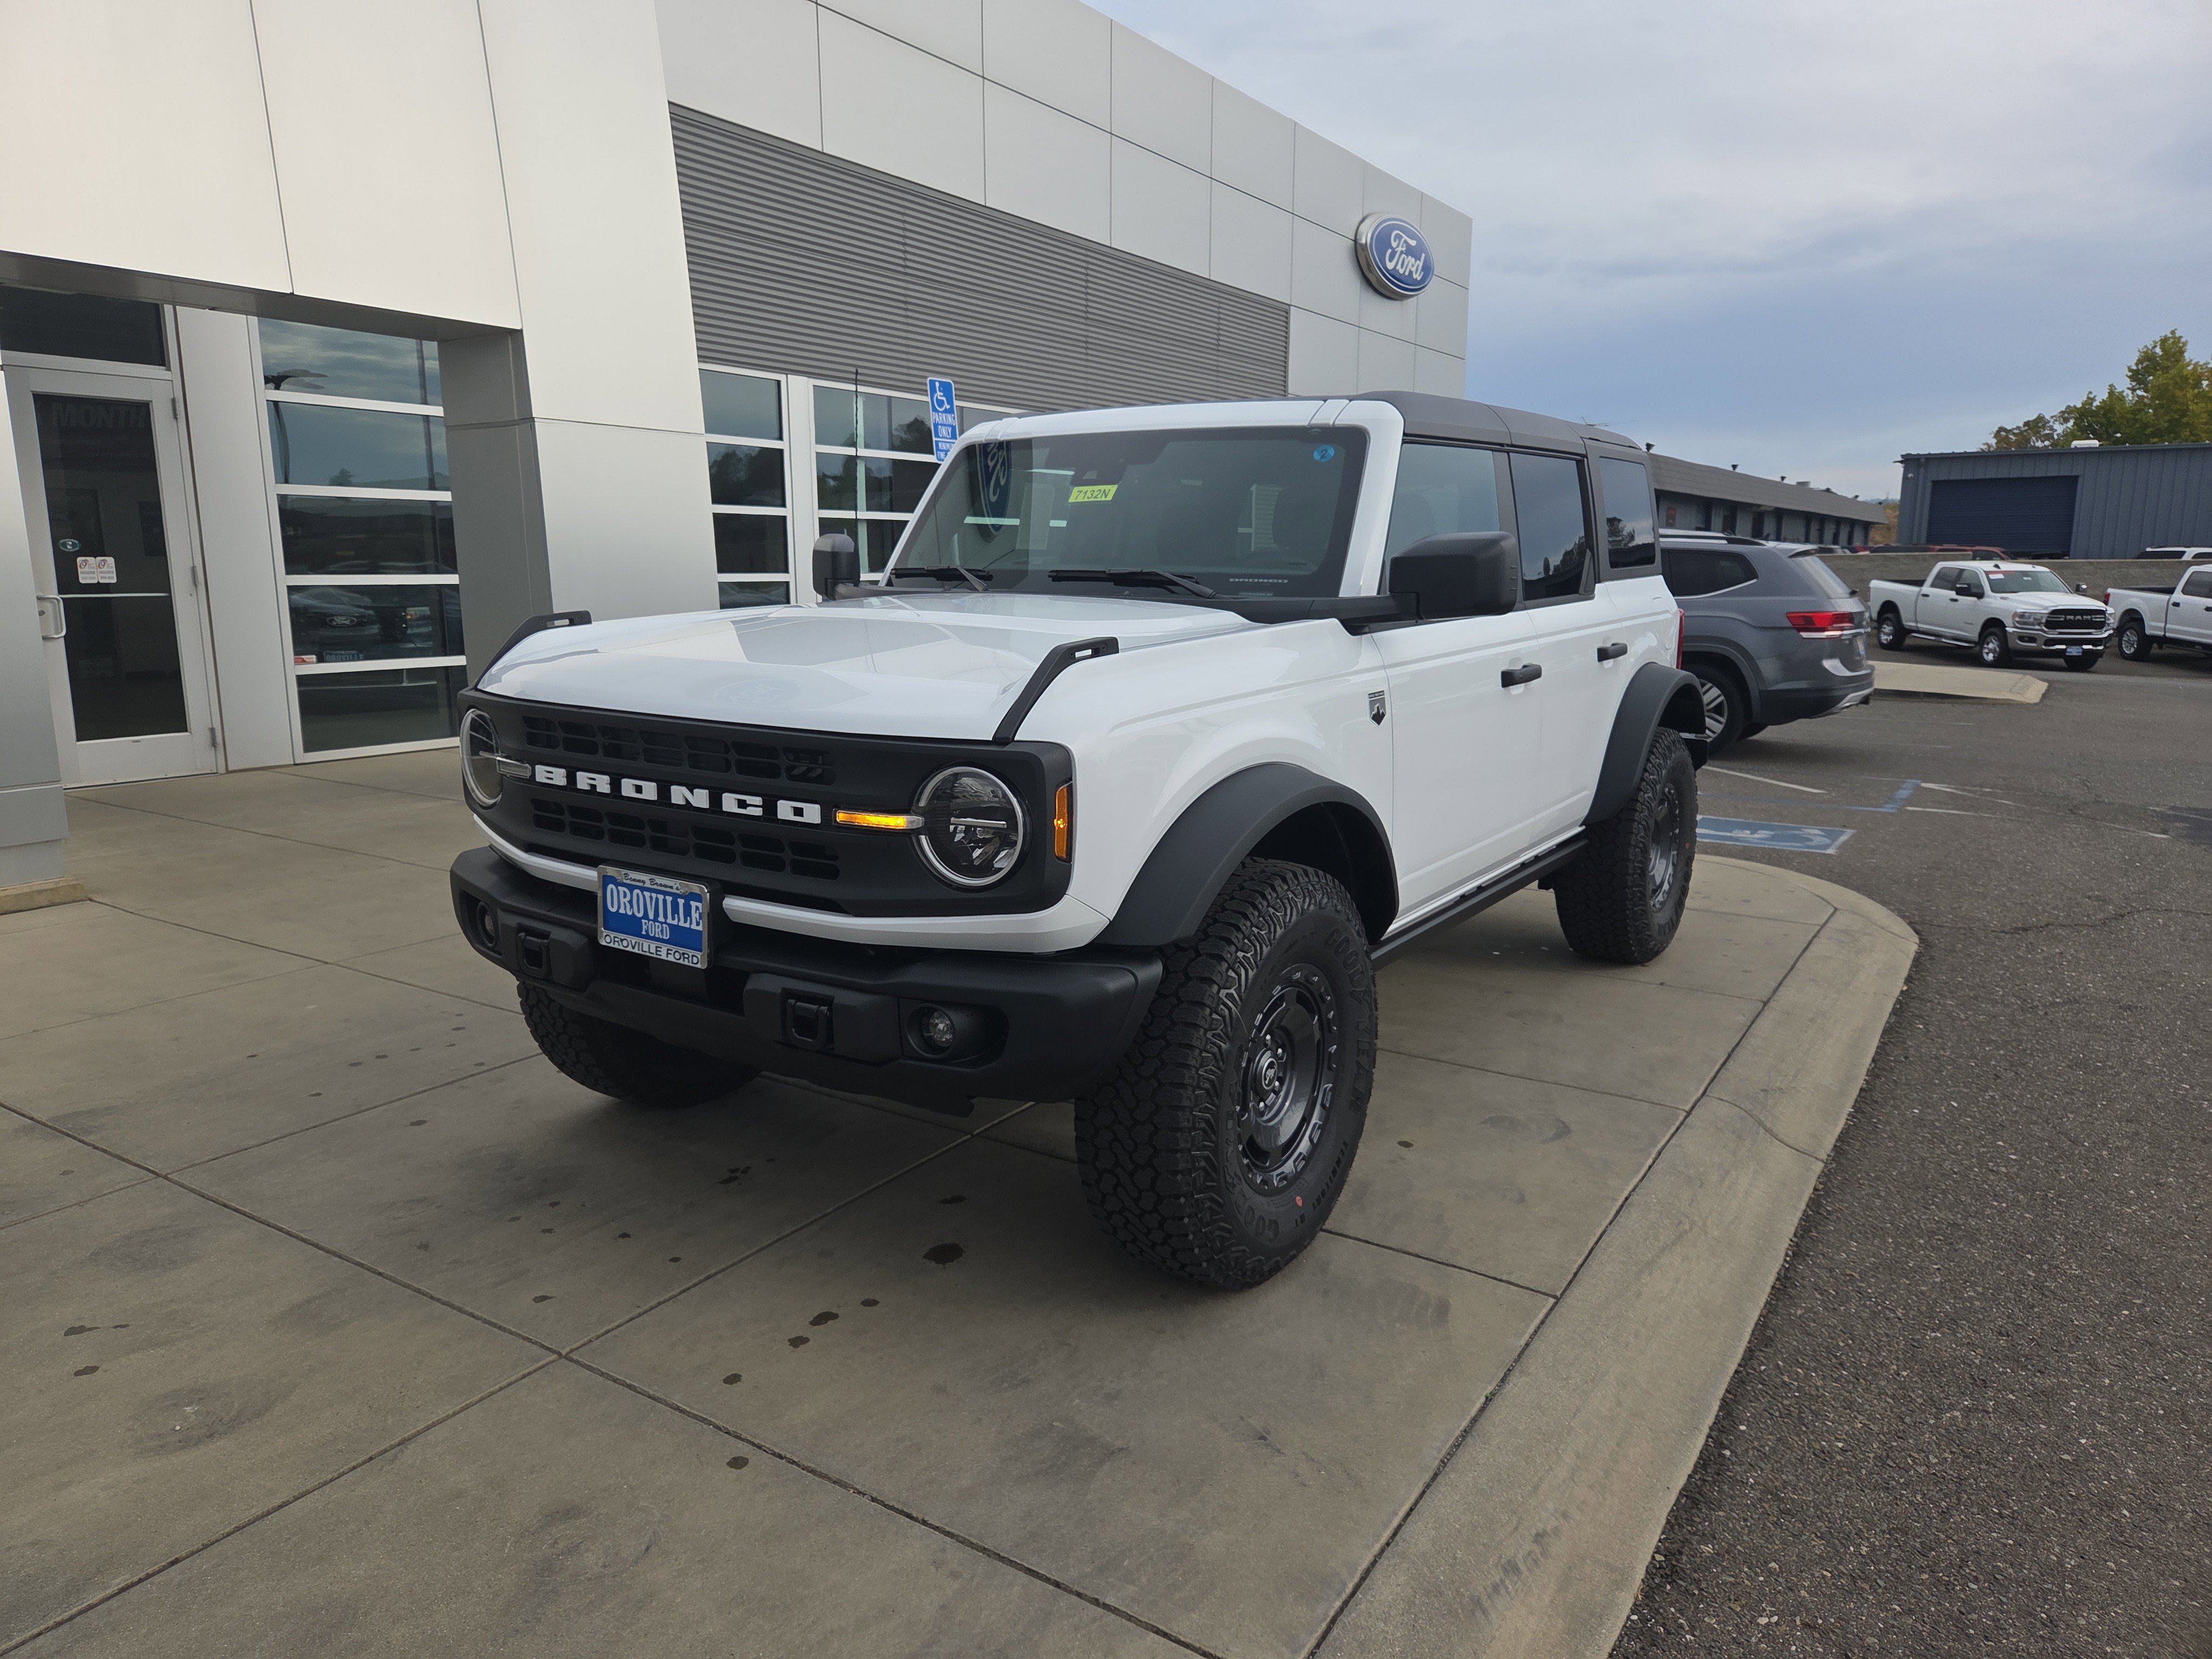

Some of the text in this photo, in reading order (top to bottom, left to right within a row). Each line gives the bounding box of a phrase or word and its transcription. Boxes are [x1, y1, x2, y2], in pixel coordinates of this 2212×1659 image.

[1386, 230, 1425, 280] Ford
[933, 412, 956, 426] PARKING
[938, 425, 951, 438] ONLY
[1075, 489, 1111, 500] 7132N
[535, 764, 821, 824] BRONCO
[623, 872, 681, 891] Benny Brown's
[606, 884, 703, 931] OROVILLE
[641, 919, 670, 940] FORD
[603, 934, 700, 965] OROVILLE FORD
[1324, 928, 1373, 1115] GOODYEAR
